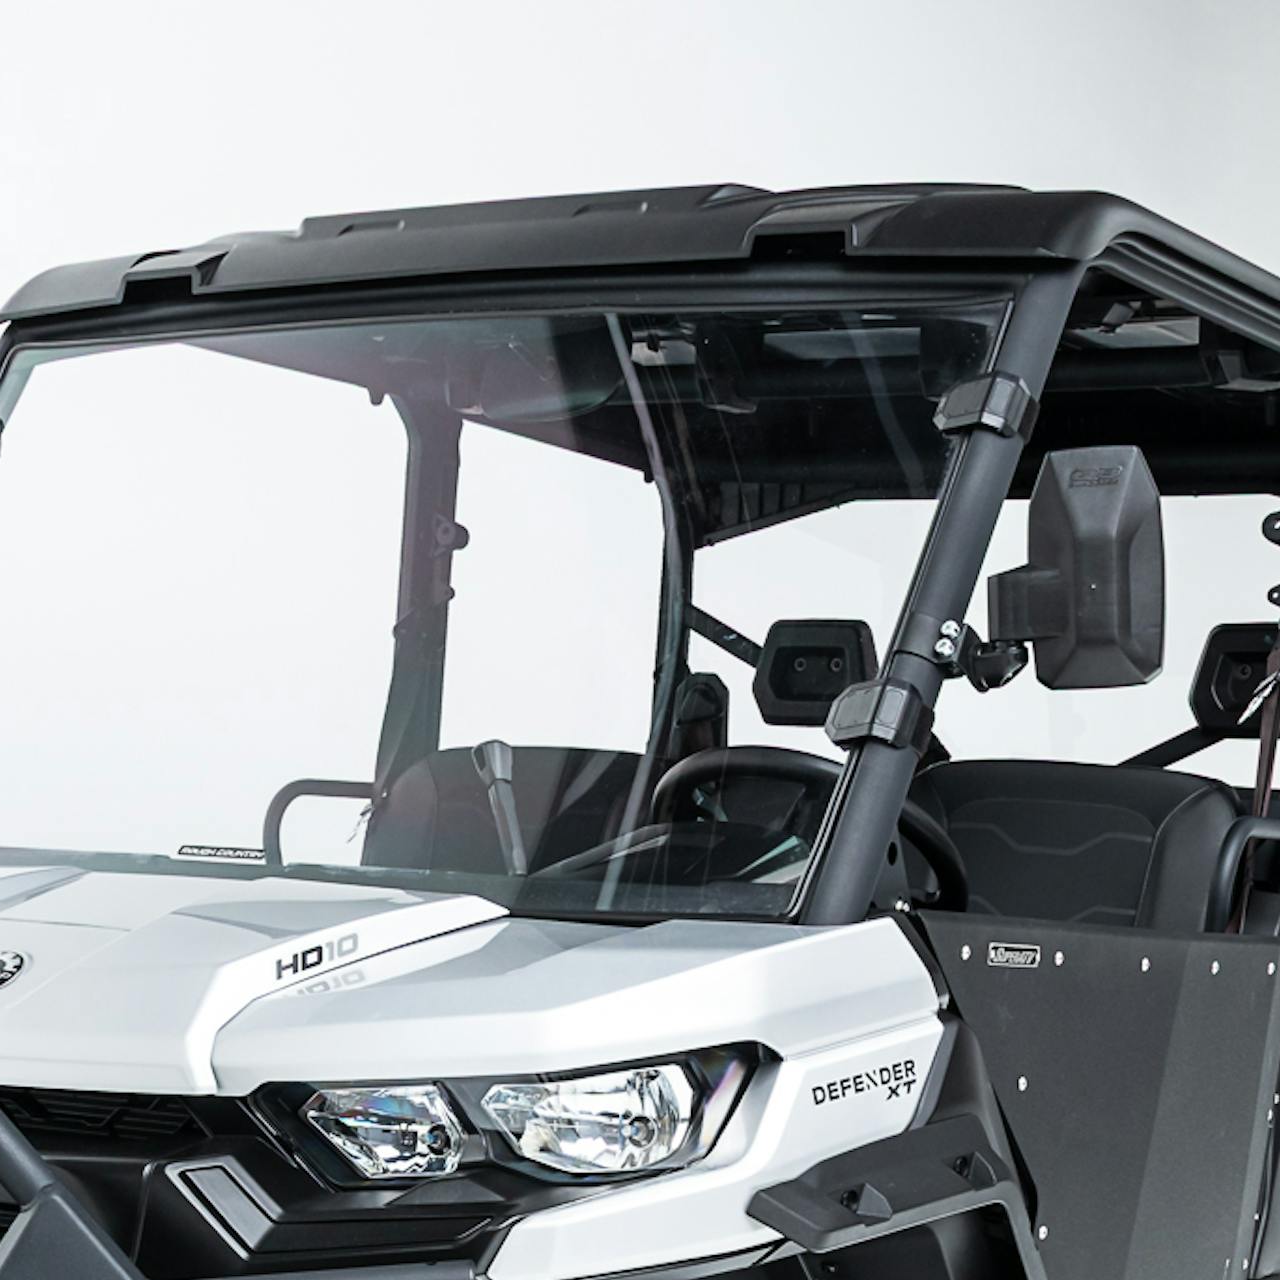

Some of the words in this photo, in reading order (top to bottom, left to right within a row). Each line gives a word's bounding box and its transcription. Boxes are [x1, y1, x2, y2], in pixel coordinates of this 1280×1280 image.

[276, 933, 358, 980] HD10
[811, 1059, 916, 1105] DEFENDER
[886, 1079, 917, 1101] XT
